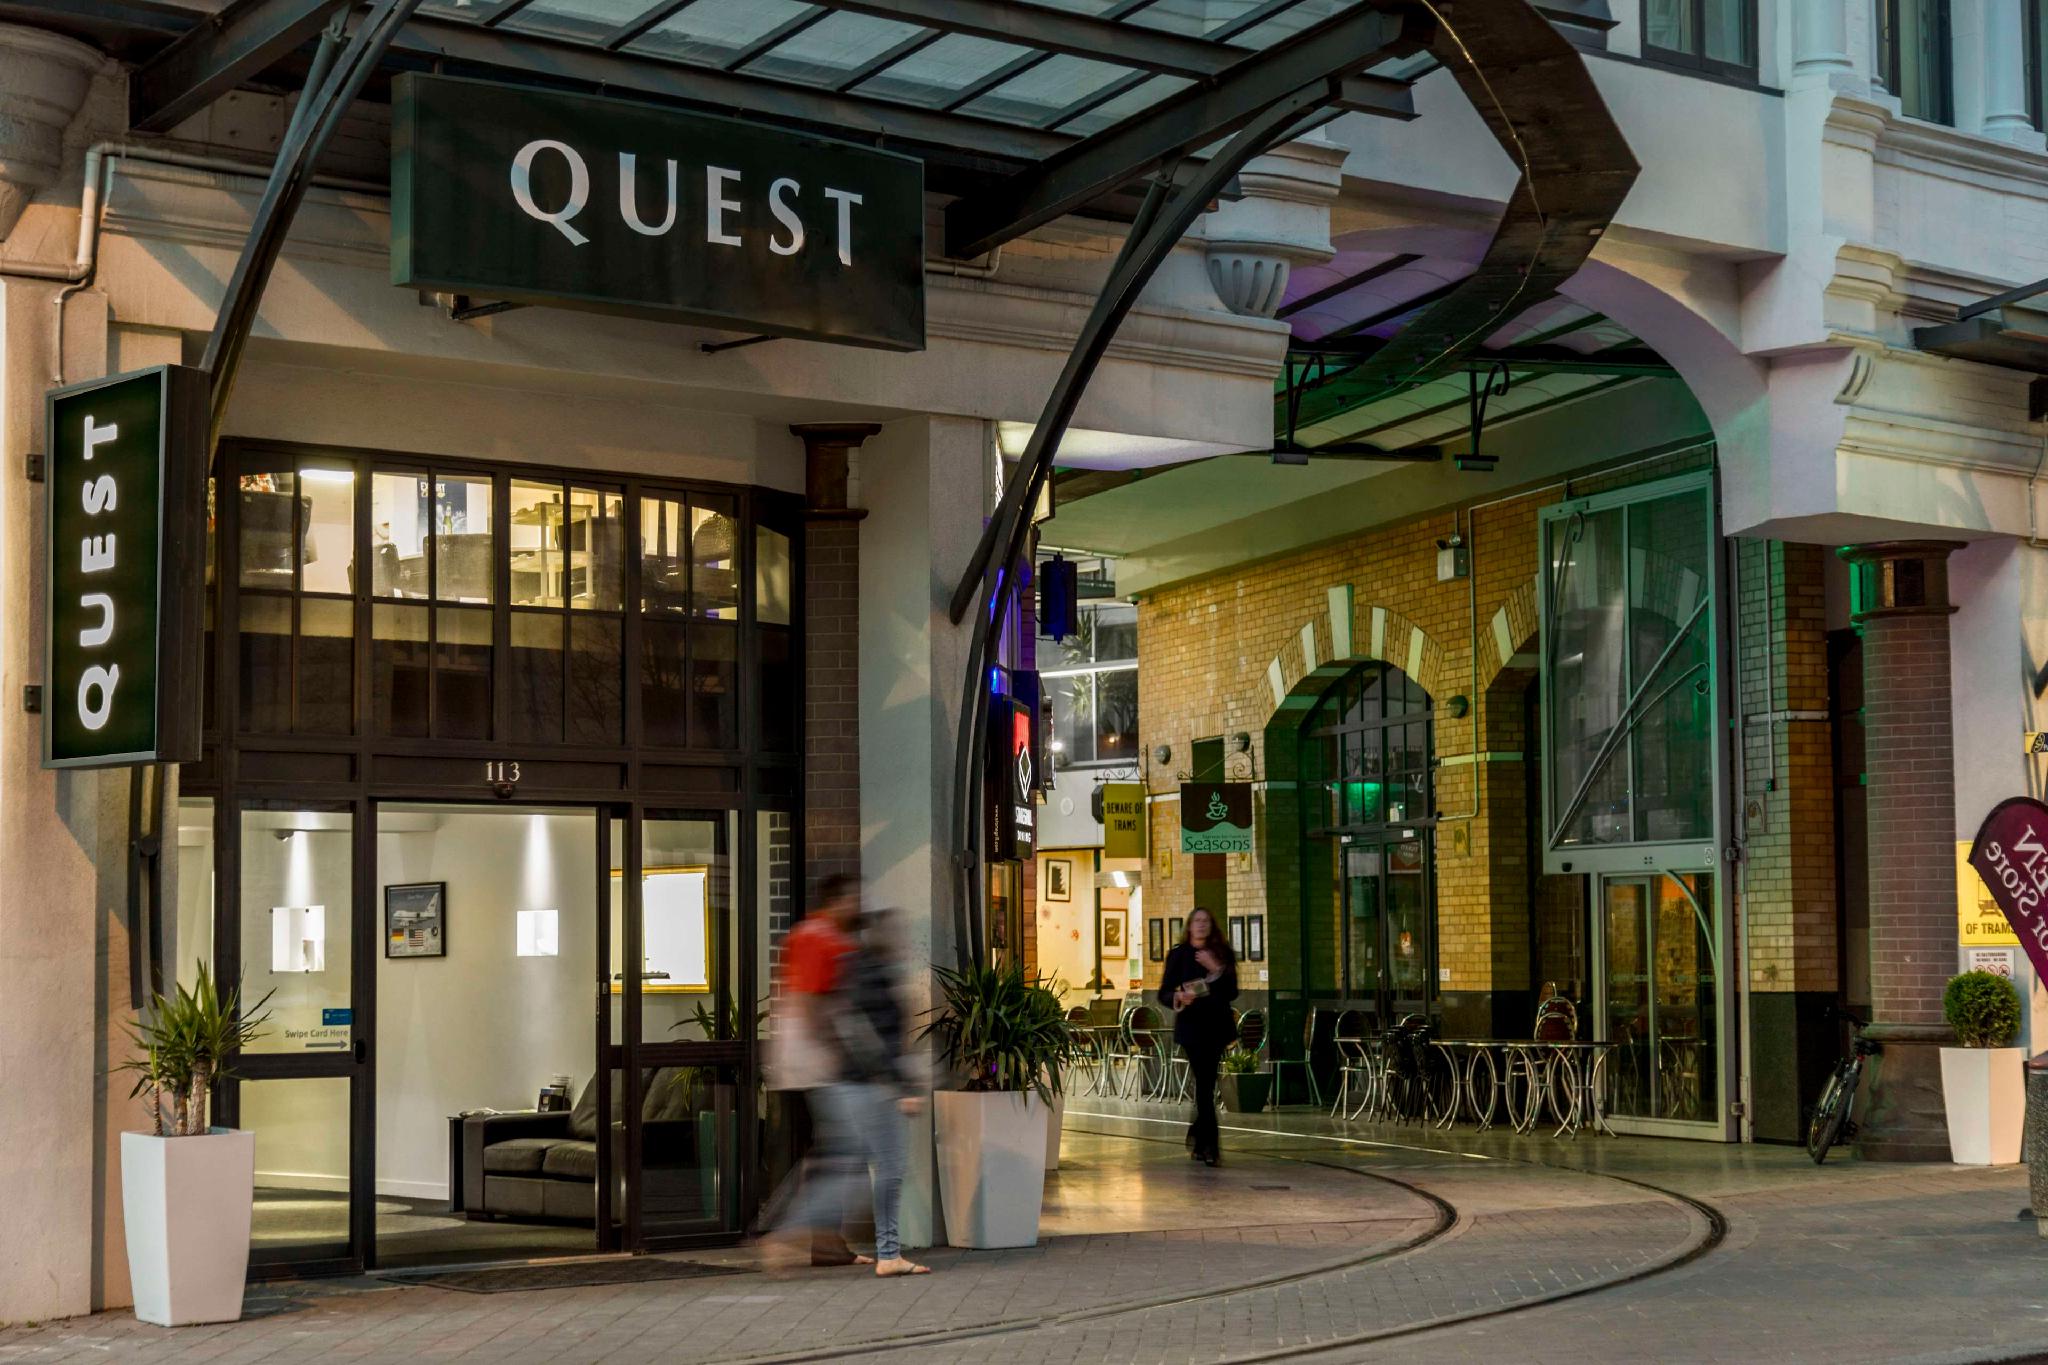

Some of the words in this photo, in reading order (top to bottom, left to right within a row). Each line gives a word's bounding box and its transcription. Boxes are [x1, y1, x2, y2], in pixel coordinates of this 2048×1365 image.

[510, 139, 863, 267] QUEST
[78, 414, 120, 730] QUEST
[485, 761, 521, 782] 113
[1106, 802, 1132, 814] BEWARE
[1134, 802, 1143, 814] OF
[1114, 820, 1137, 832] TRAMS
[1185, 836, 1250, 852] Seasons
[1966, 923, 1978, 934] OF
[1981, 922, 2014, 935] TRAM
[285, 1030, 308, 1039] Swipe
[310, 1029, 329, 1038] Card
[330, 1029, 348, 1038] Here
